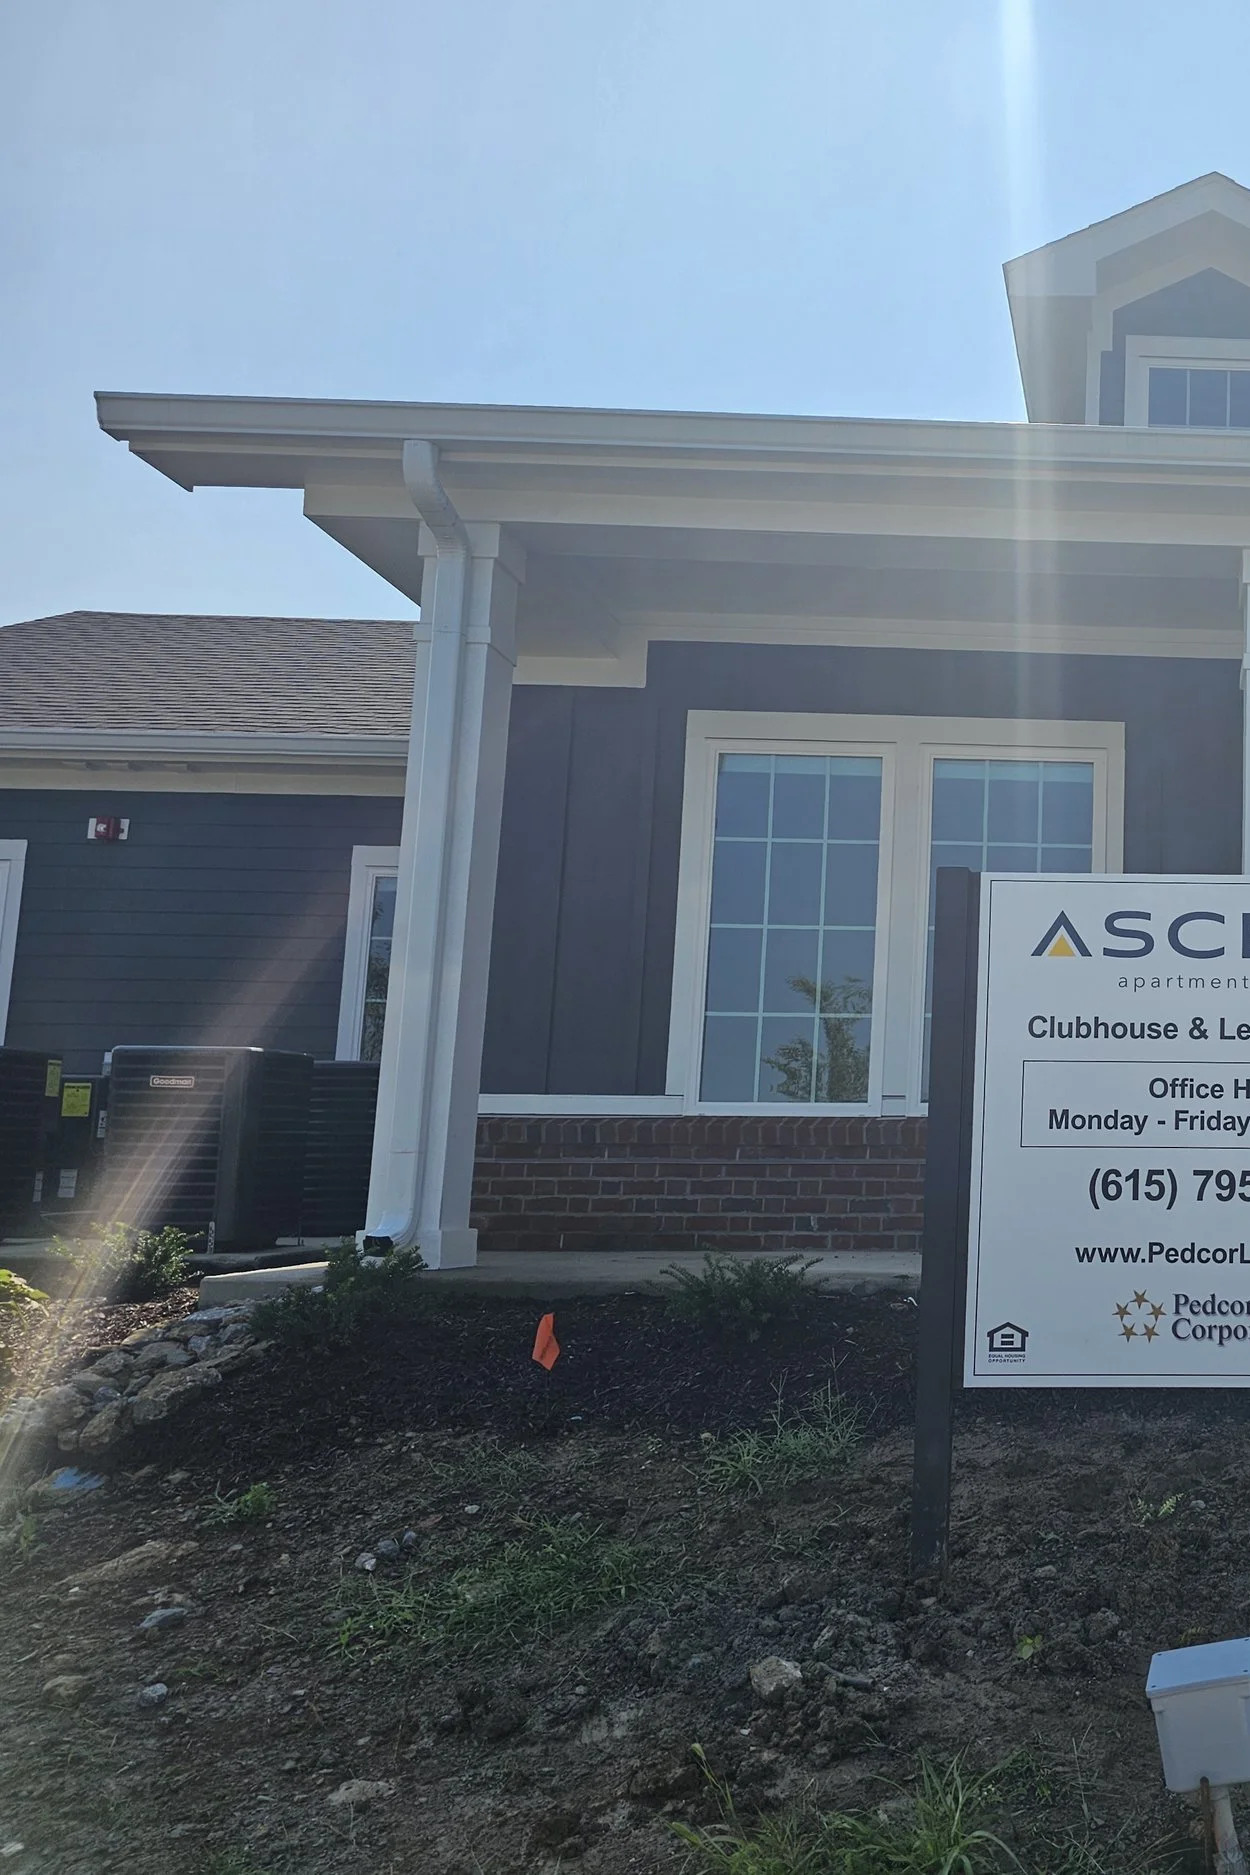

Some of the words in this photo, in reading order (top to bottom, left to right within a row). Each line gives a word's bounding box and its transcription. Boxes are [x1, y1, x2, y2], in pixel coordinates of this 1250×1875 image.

[1117, 973, 1250, 993] apartment
[1027, 1015, 1179, 1040] Clubhouse
[1188, 1016, 1209, 1040] &
[1148, 1077, 1225, 1100] Office
[1048, 1108, 1149, 1136] Monday
[1088, 1167, 1178, 1211] (615)
